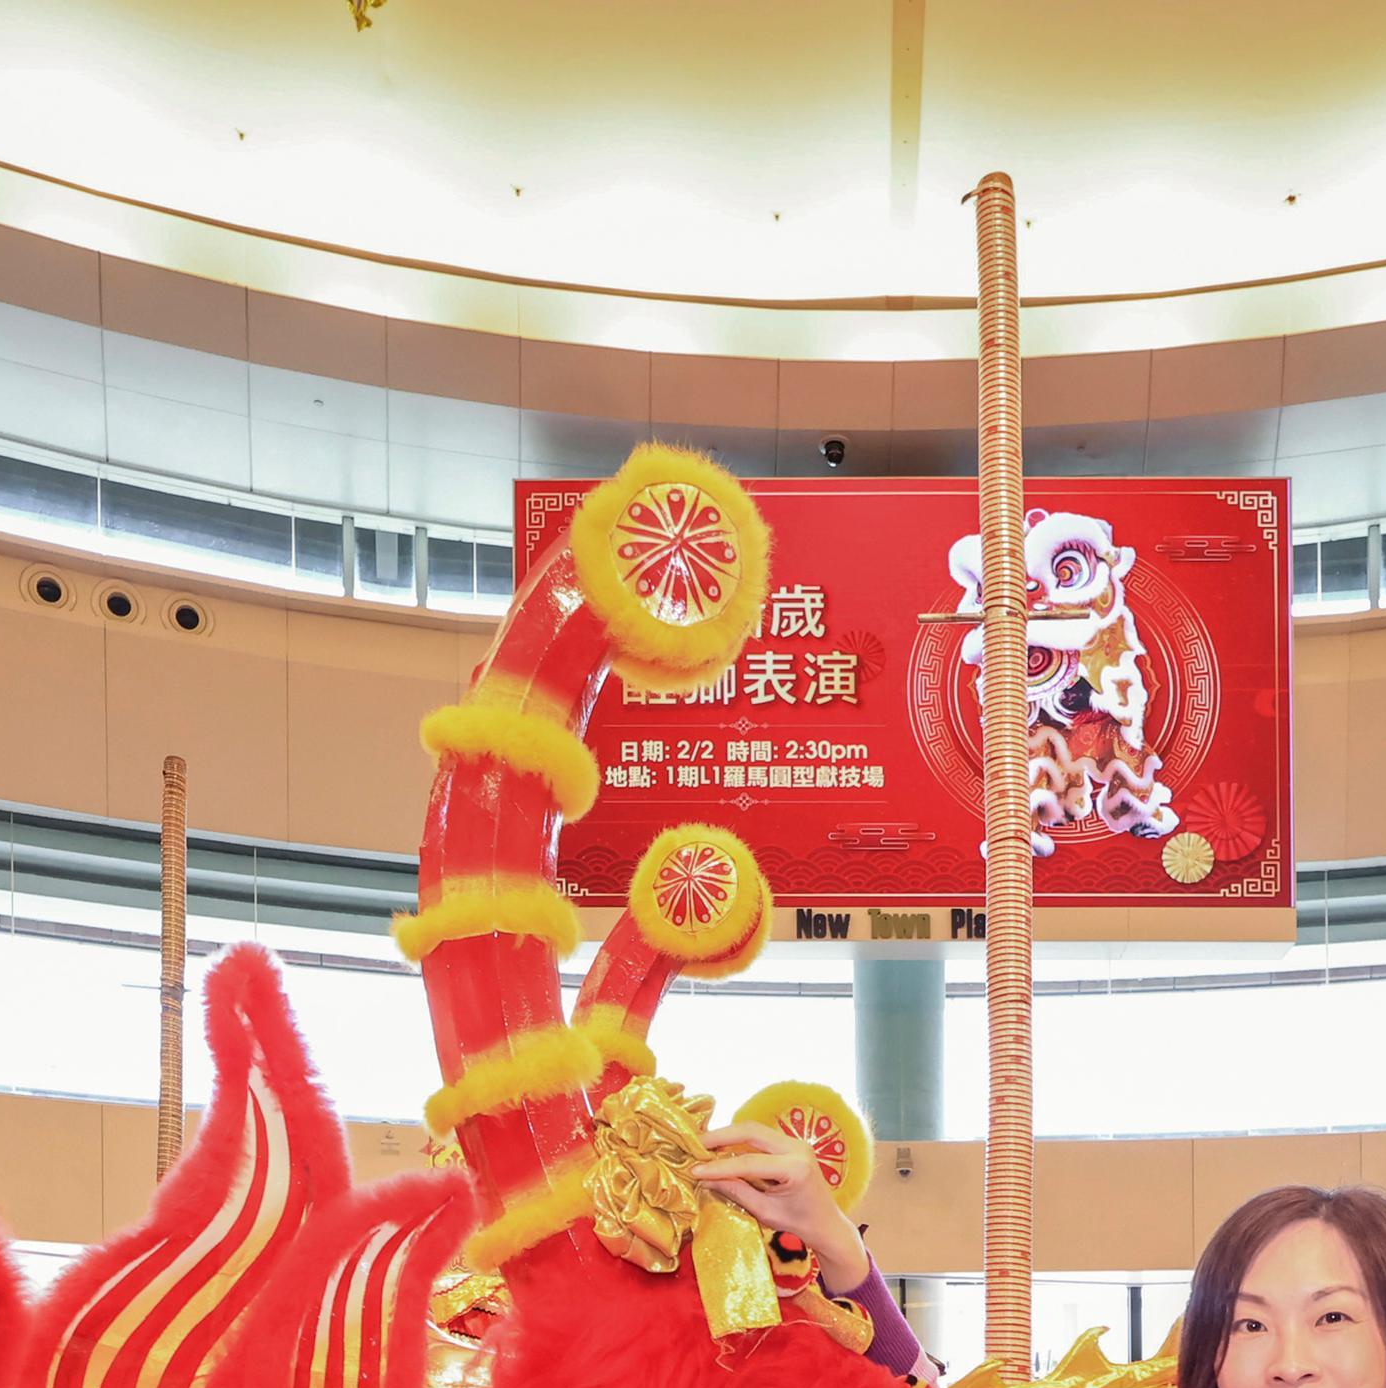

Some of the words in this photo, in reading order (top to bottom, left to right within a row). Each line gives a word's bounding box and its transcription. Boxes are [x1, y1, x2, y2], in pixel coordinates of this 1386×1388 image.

[676, 740, 715, 763] 2/2
[784, 740, 869, 764] 2:30pm
[796, 908, 851, 939] New
[867, 908, 932, 940] Town
